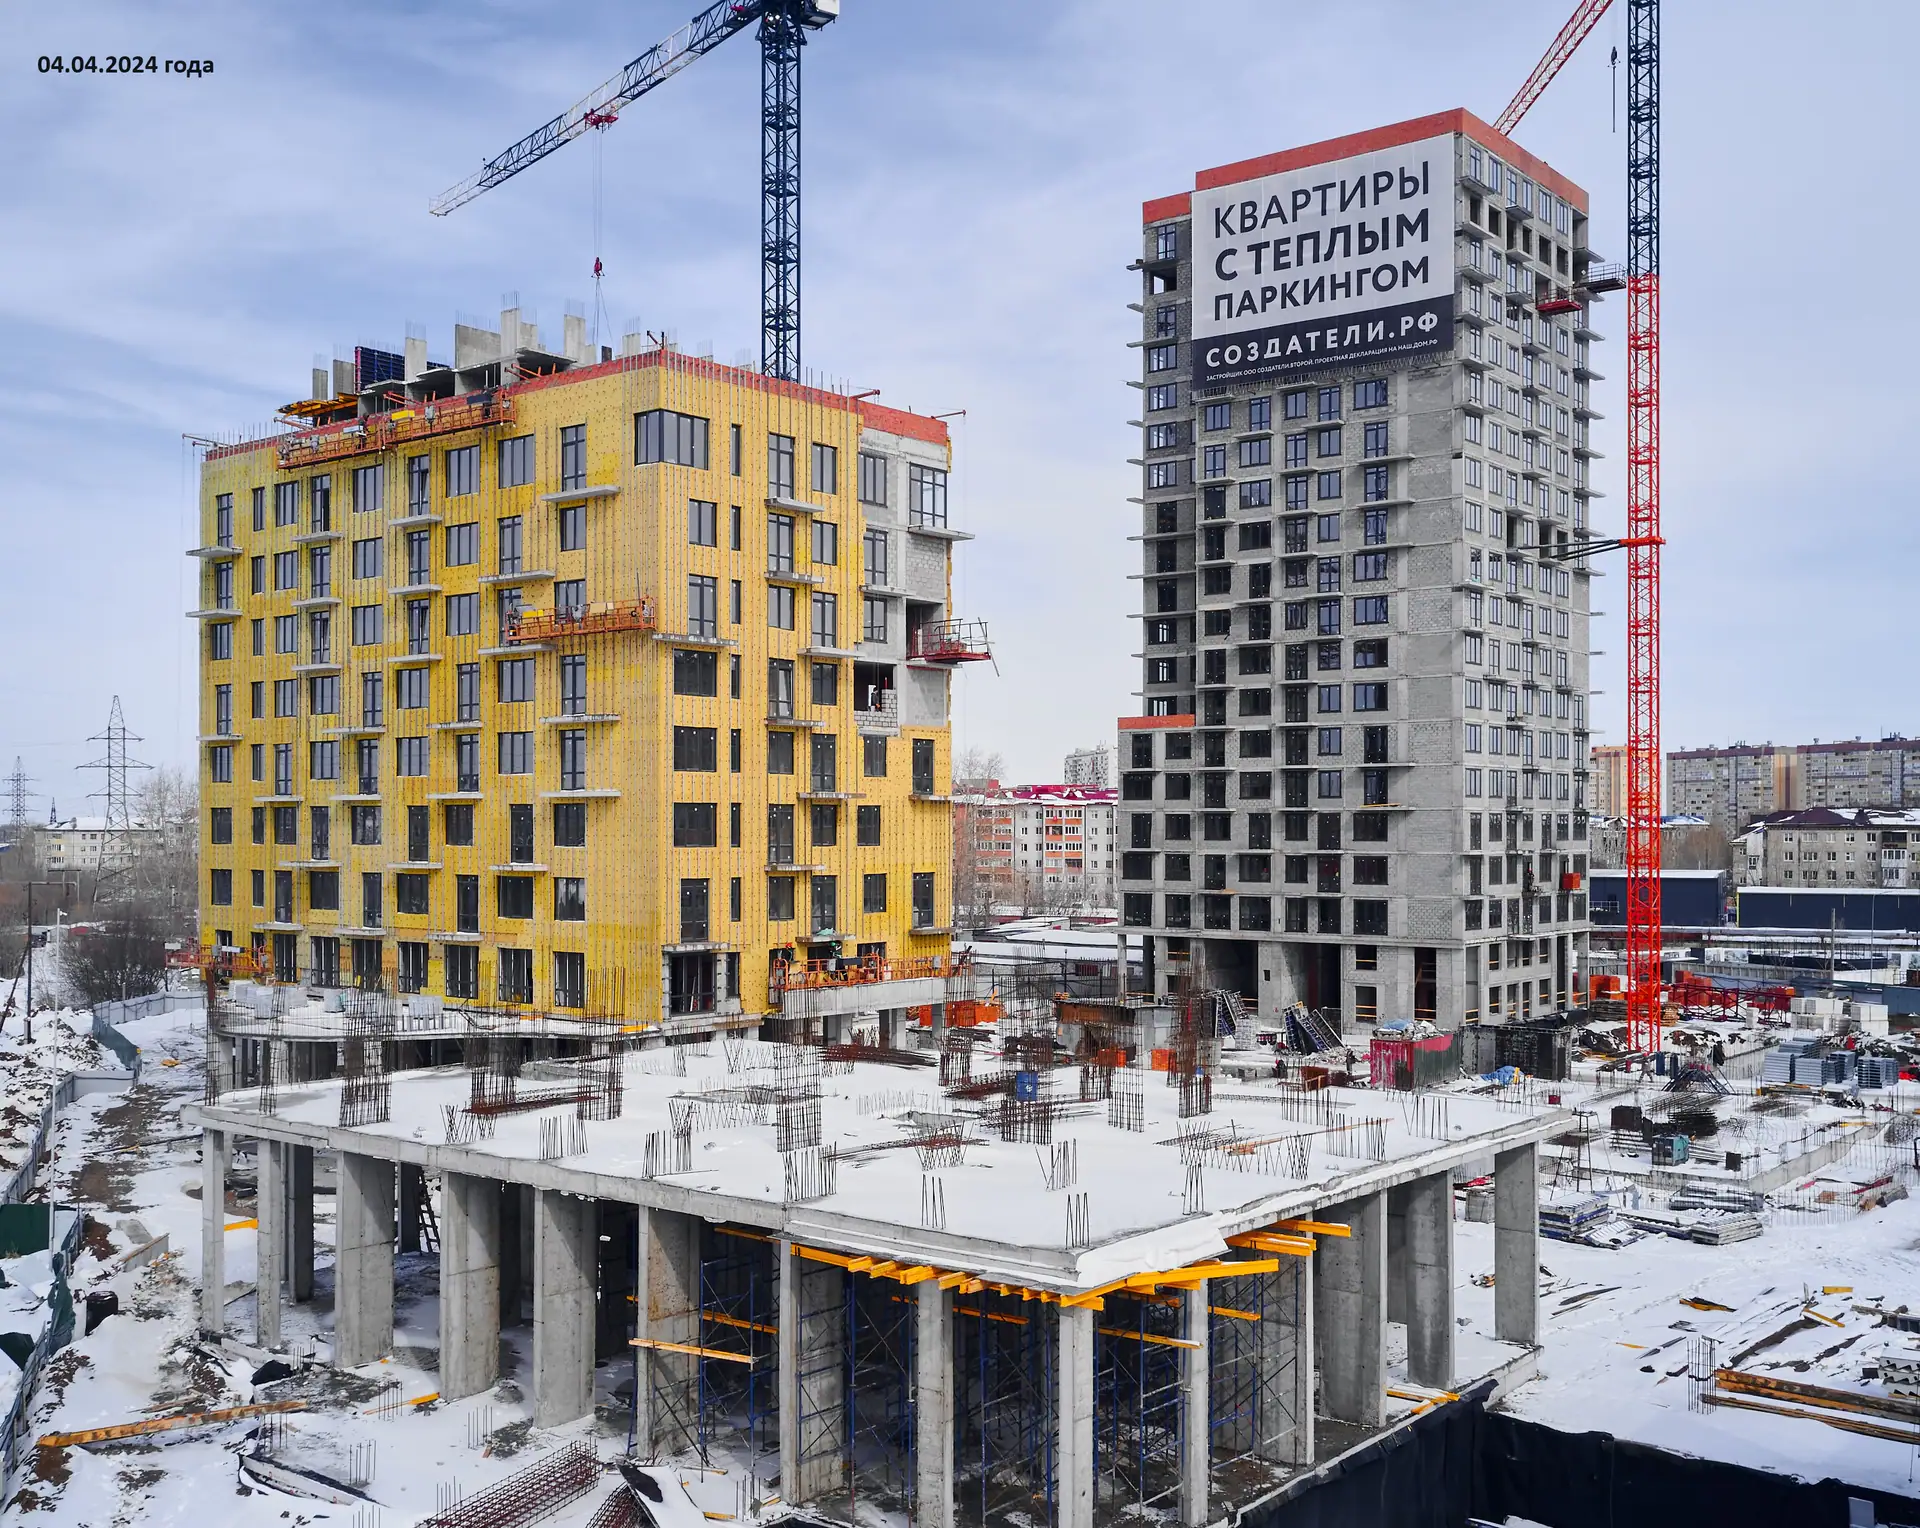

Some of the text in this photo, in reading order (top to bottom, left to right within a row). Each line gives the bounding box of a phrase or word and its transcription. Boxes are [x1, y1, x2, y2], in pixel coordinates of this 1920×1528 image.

[1214, 161, 1429, 239] КВАРТИРЫ
[1215, 208, 1429, 281] С ТЕПЛЫМ
[1214, 256, 1429, 321] ПАРКИНГОМ
[1206, 311, 1438, 367] СОЗДАТЕЛИ.РФ
[1206, 371, 1243, 381] ЗАСТРОЙЩИК
[1243, 368, 1257, 376] ООО
[1314, 353, 1348, 364] ПРОЕКТНАЯ
[1348, 347, 1388, 359] ДЕКЛАРАЦИЯ
